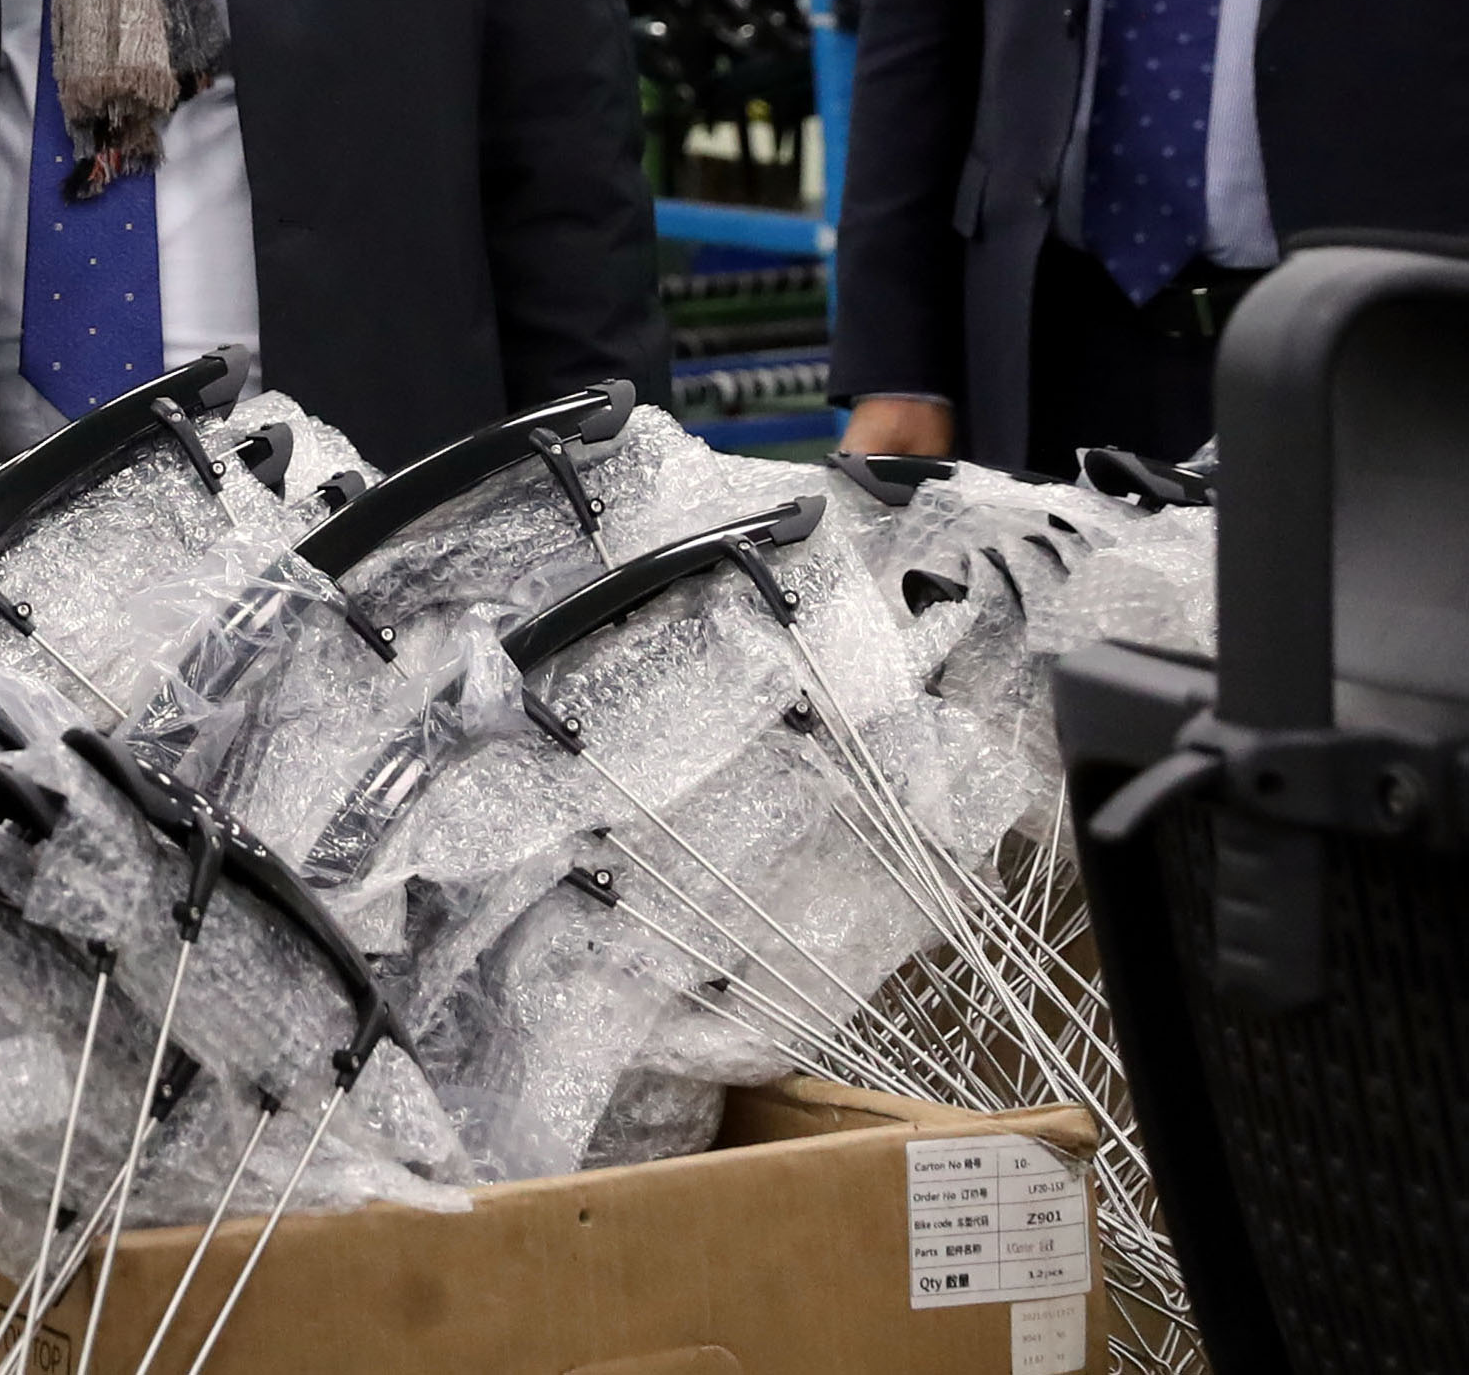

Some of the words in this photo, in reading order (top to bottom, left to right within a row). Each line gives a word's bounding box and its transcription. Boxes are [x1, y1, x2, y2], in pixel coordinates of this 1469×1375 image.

[1027, 1210, 1062, 1225] Z901
[919, 1276, 942, 1292] Qty
[33, 1336, 61, 1373] TOP
